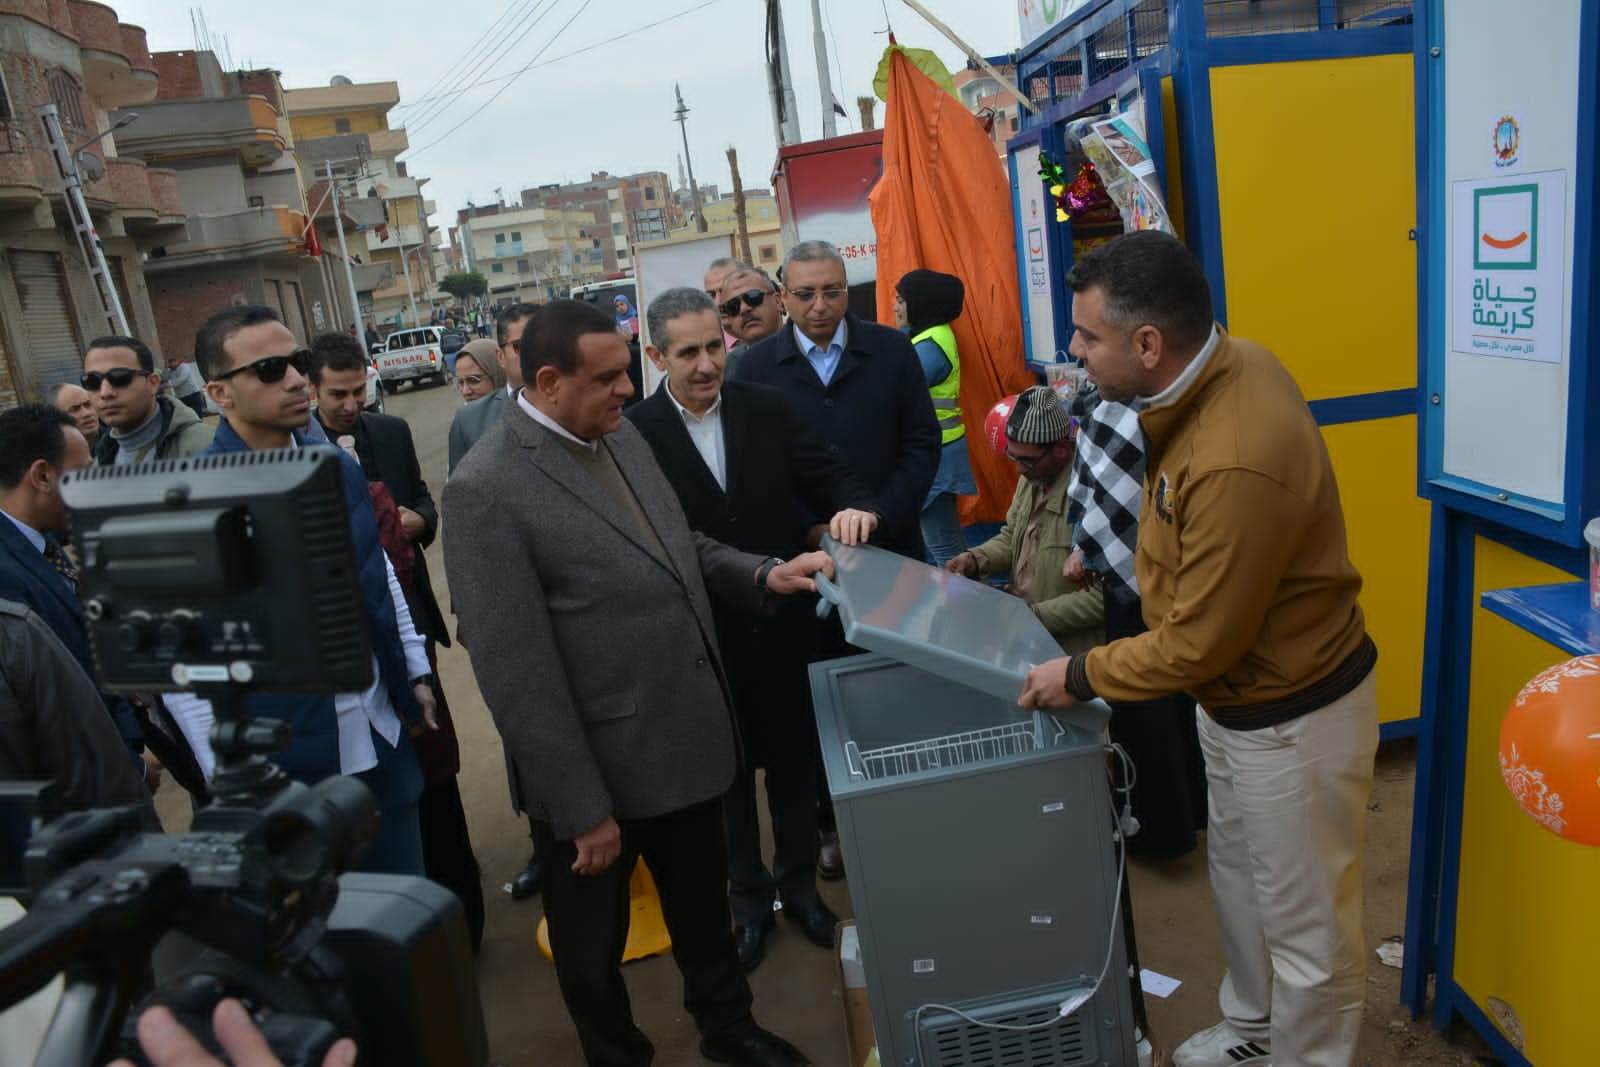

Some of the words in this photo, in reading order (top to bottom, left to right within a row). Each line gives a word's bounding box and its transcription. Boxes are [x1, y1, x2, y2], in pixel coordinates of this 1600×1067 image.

[1473, 277, 1536, 308] حياة
[1473, 303, 1535, 334] كريمة
[384, 354, 422, 366] NISSAN
